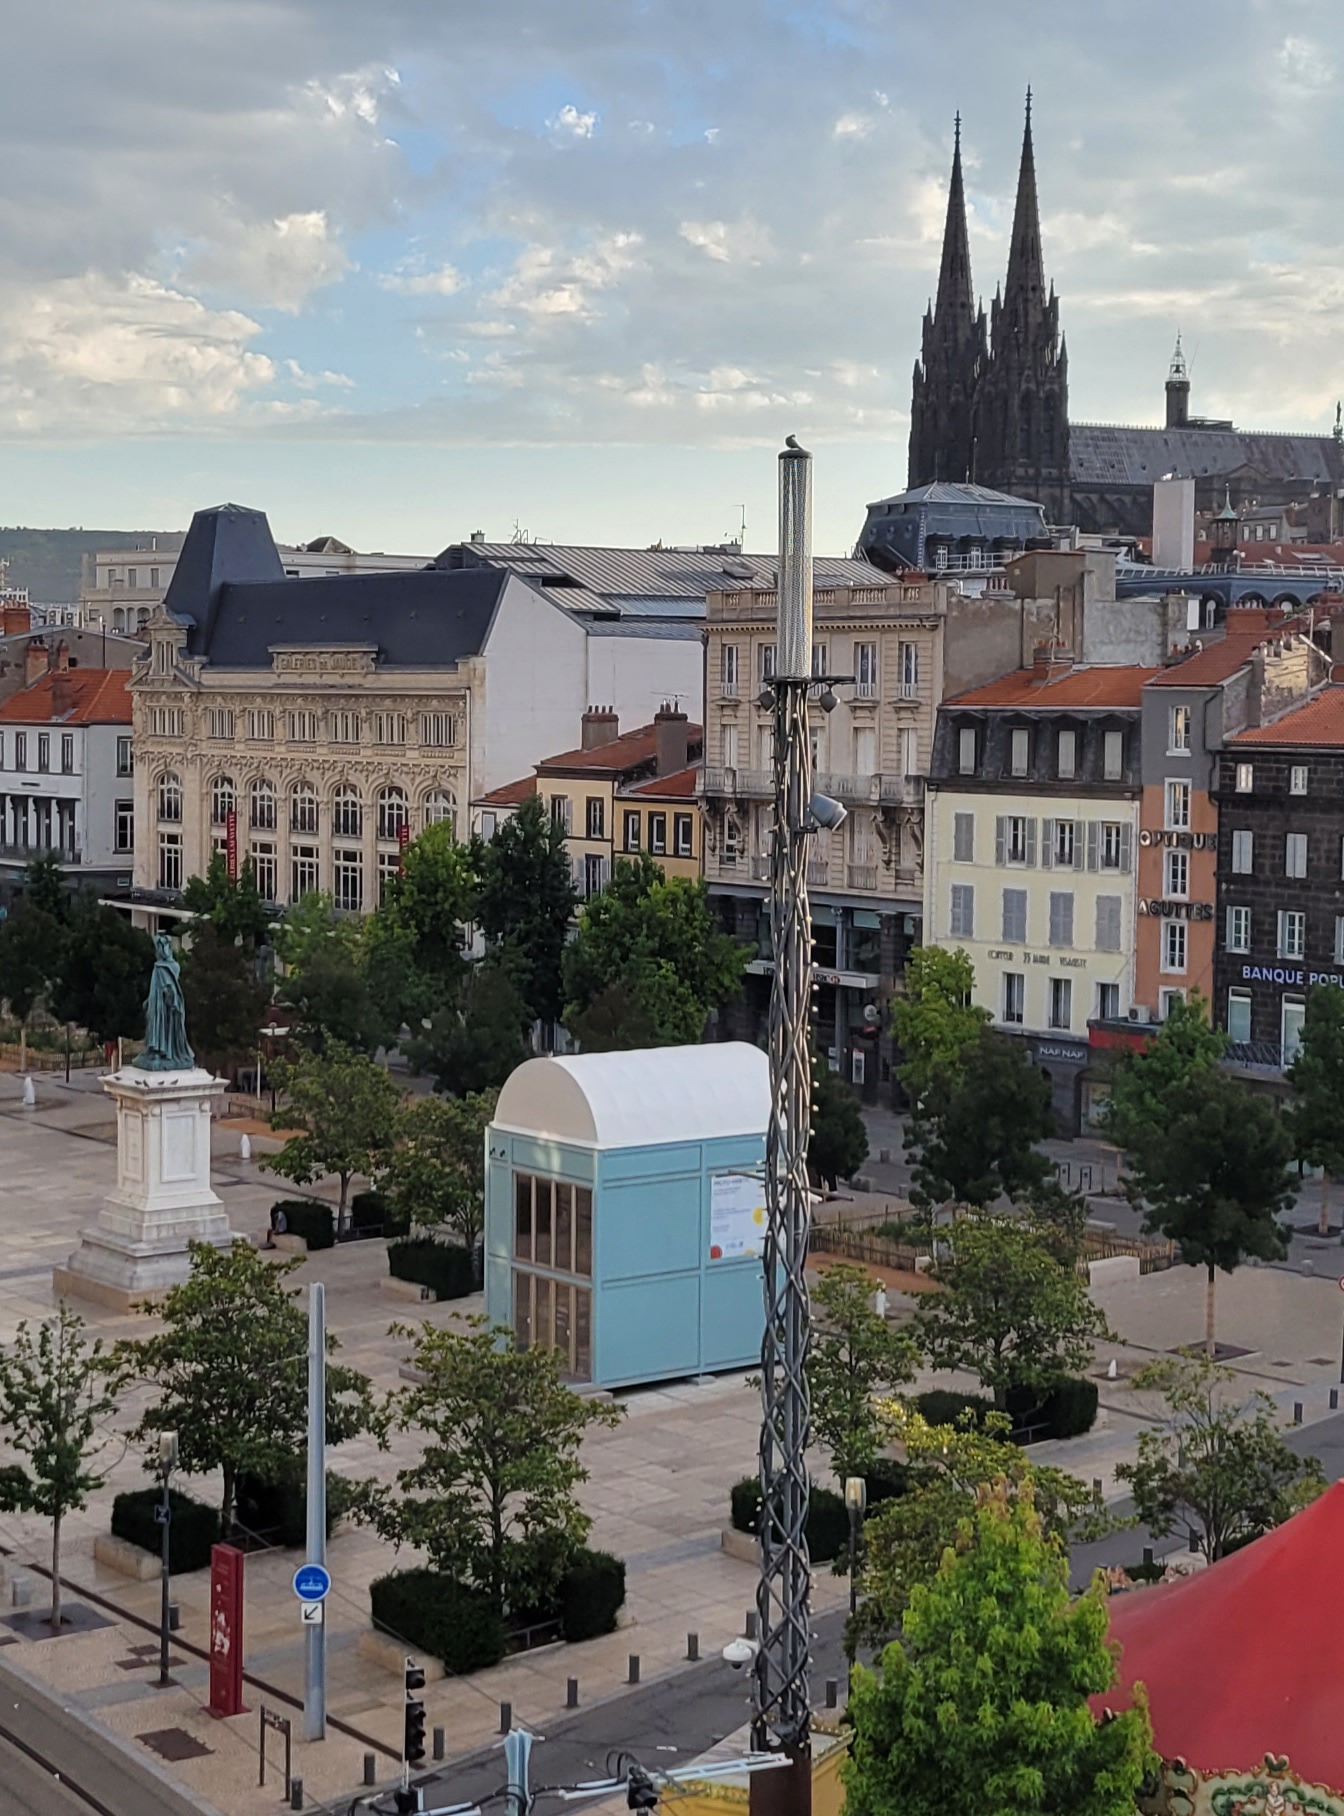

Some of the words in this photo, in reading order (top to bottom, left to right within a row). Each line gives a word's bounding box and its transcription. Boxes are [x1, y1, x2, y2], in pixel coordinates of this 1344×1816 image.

[1140, 829, 1217, 851] OPTIQUE
[1138, 899, 1214, 920] AGUTTES
[1242, 965, 1304, 985] BANQUE
[1040, 1047, 1061, 1056] NAF
[1062, 1049, 1084, 1059] NAF
